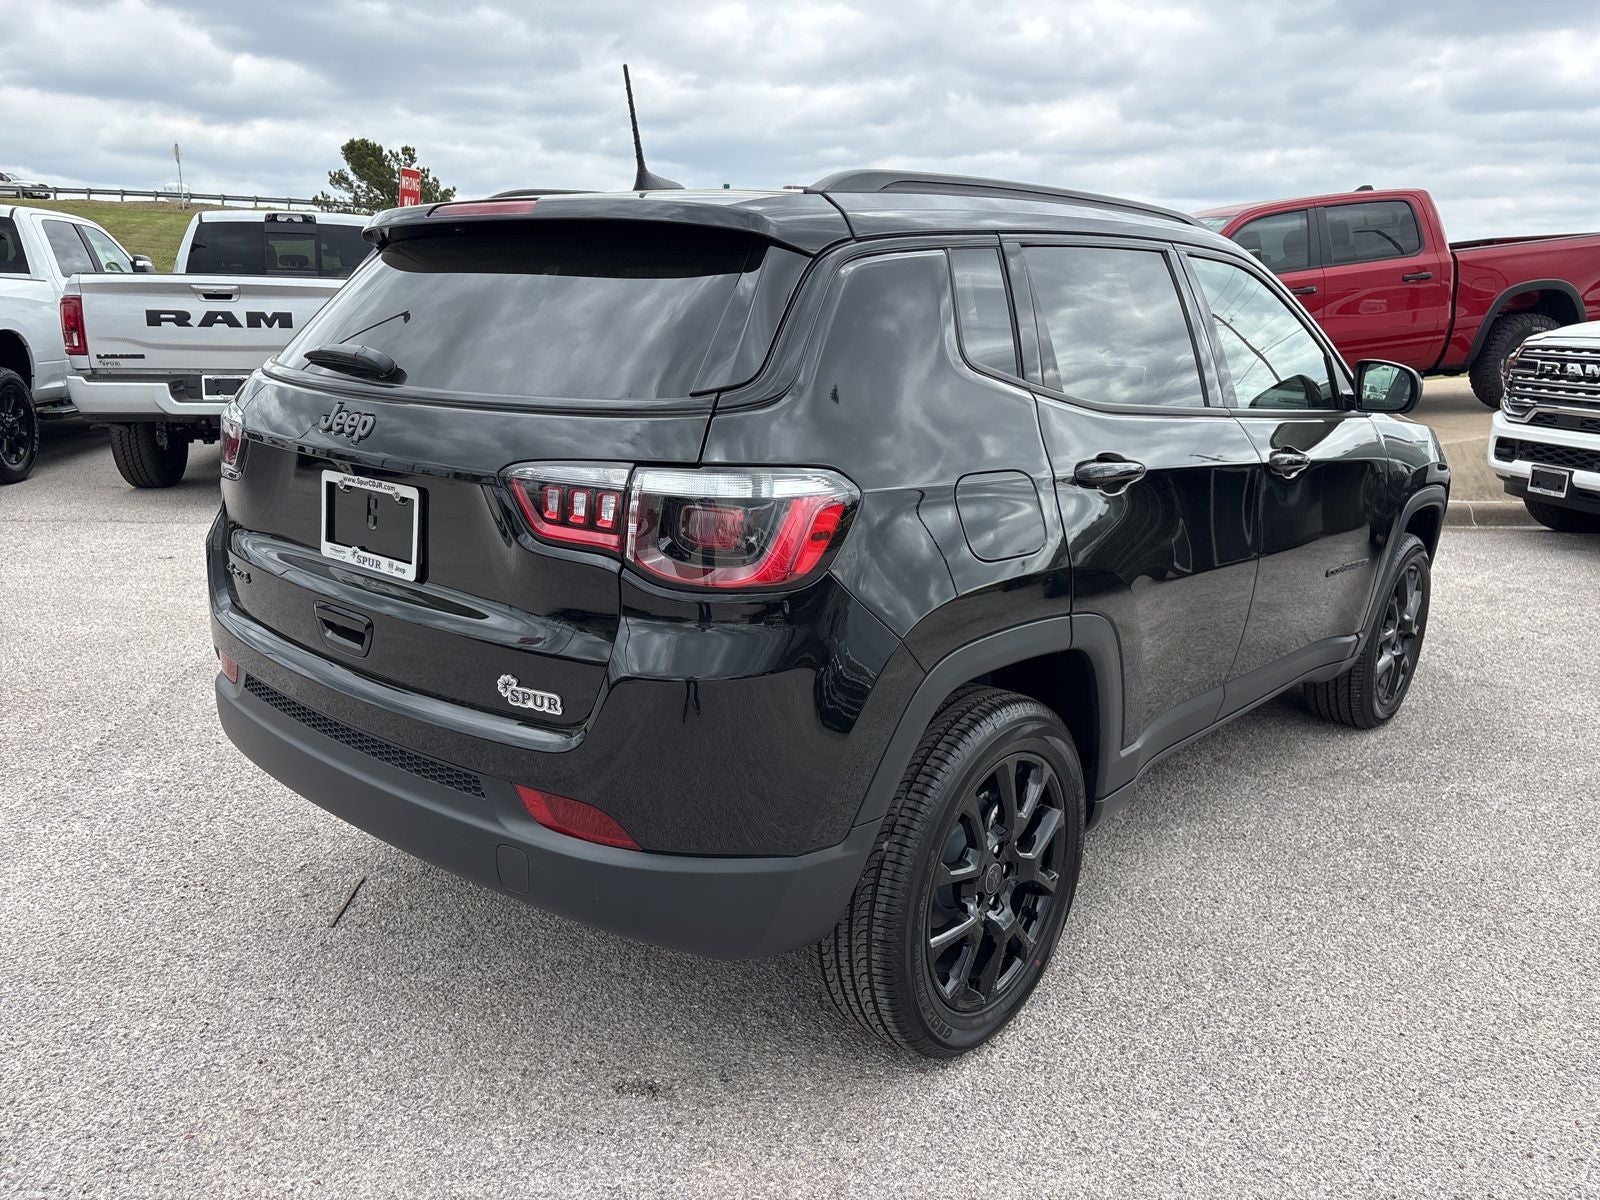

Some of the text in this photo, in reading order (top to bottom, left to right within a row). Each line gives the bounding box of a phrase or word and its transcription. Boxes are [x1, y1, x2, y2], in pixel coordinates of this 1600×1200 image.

[401, 175, 420, 192] WRONG
[145, 309, 294, 329] RAM
[319, 401, 377, 446] Jeep
[342, 475, 396, 493] www.SpurCDJR.com
[355, 554, 381, 570] SPUR
[394, 563, 407, 575] Jeep
[510, 689, 559, 712] SPUR
